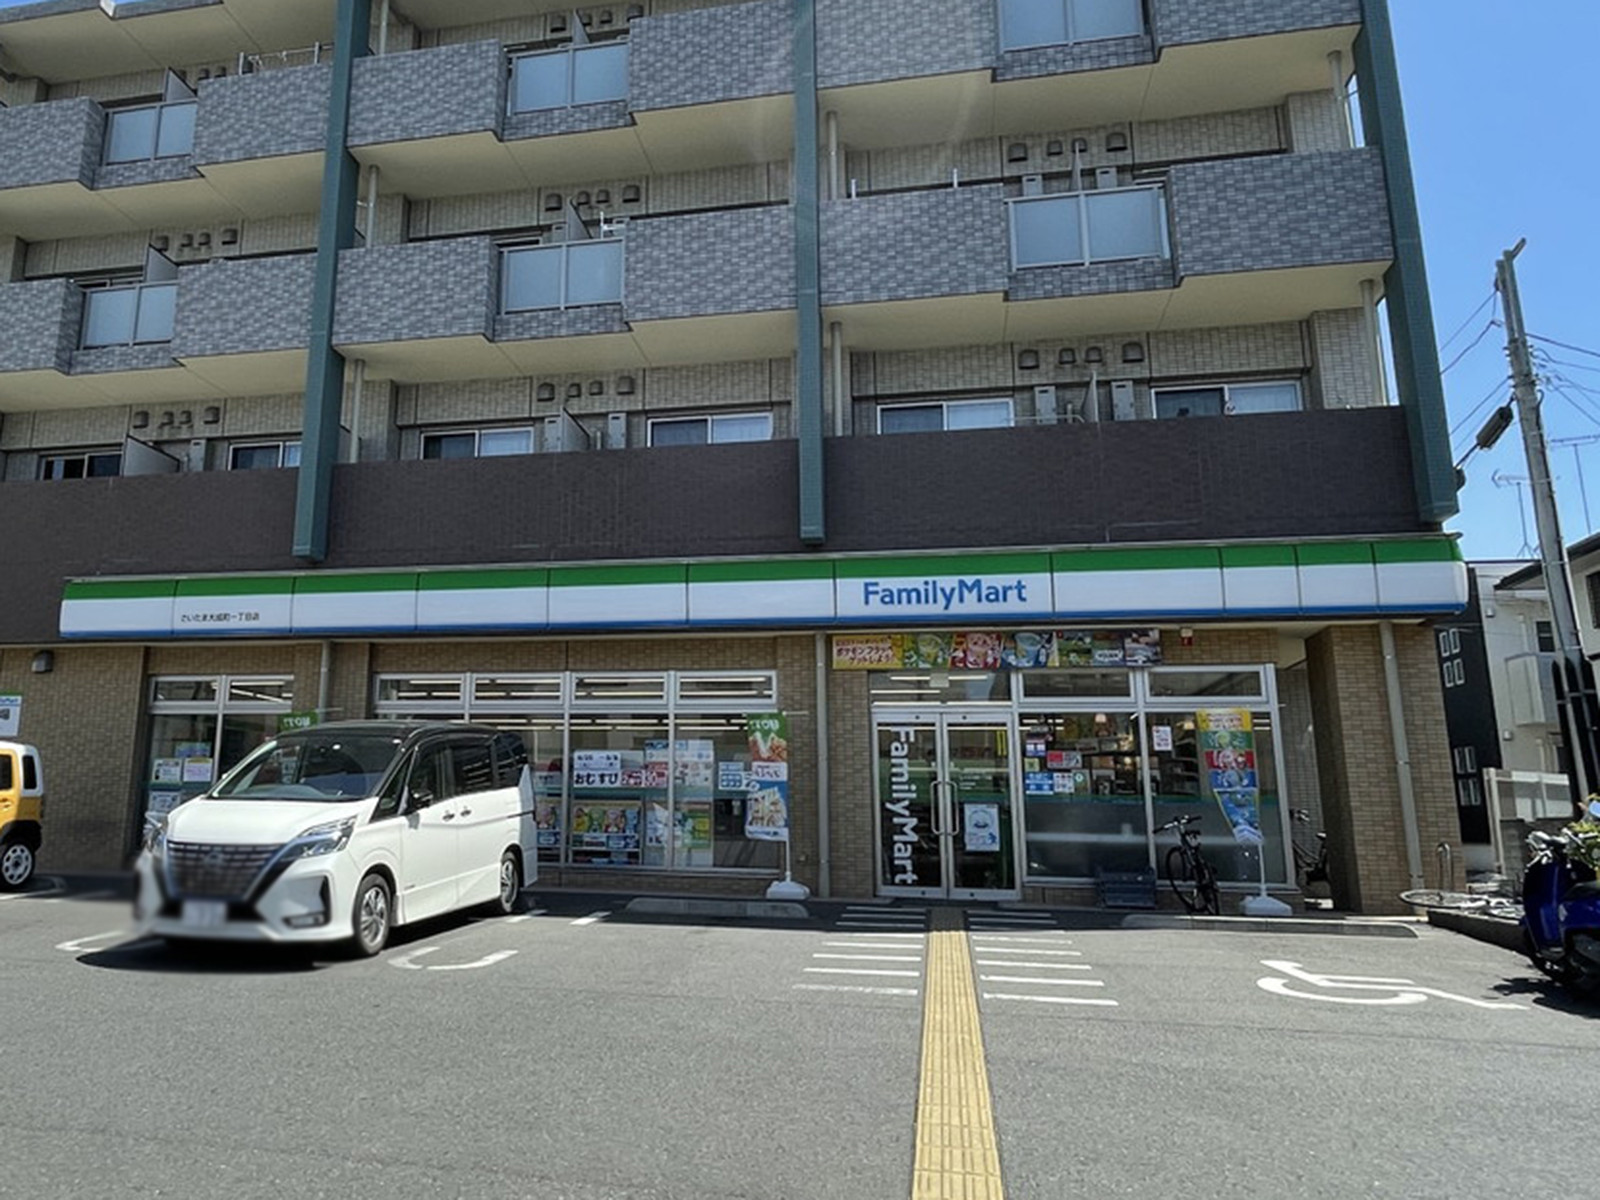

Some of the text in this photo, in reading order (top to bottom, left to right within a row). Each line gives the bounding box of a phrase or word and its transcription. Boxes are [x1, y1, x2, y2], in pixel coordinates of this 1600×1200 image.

[863, 579, 1027, 610] FamilyMart
[574, 772, 619, 786] おむすび
[885, 726, 919, 884] FamilyMart
